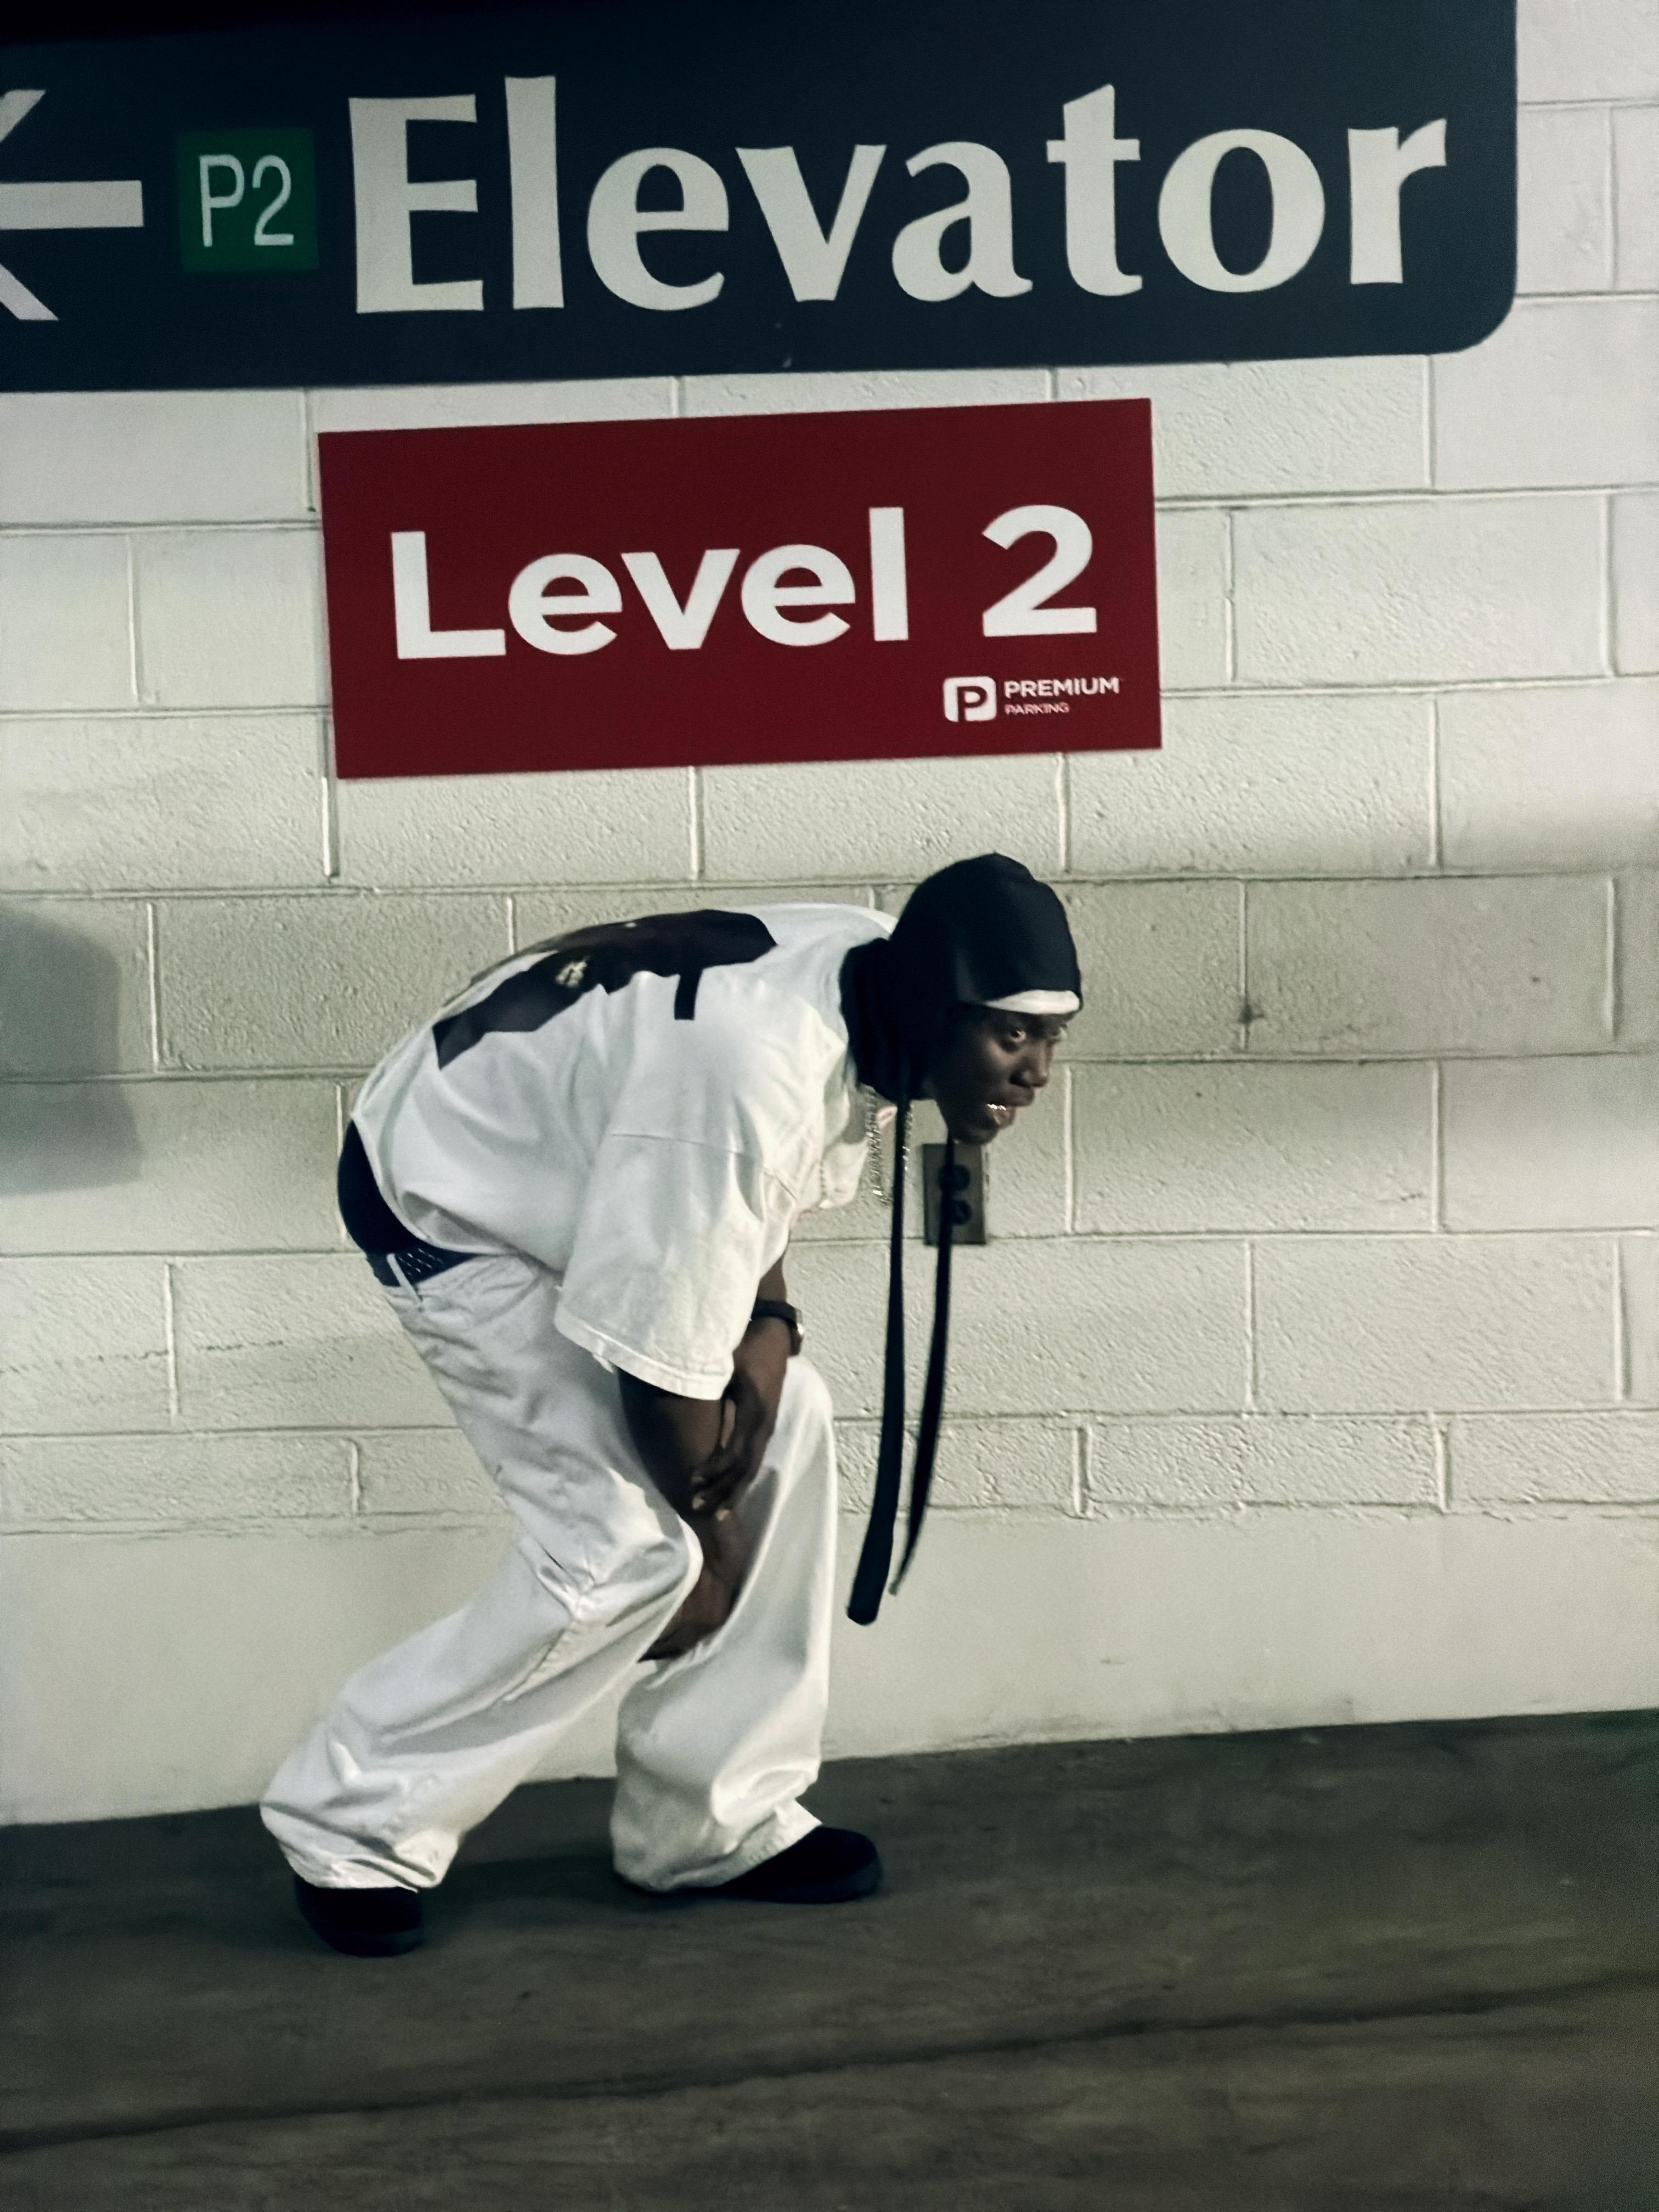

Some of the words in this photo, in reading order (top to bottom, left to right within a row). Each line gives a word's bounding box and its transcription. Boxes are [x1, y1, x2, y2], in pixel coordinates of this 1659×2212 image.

[199, 154, 295, 248] P2
[348, 76, 1448, 314] Elevator
[391, 506, 910, 660] Level
[982, 504, 1098, 637] 2
[1003, 676, 1120, 699] PREMIUM
[1005, 702, 1070, 715] PARKING
